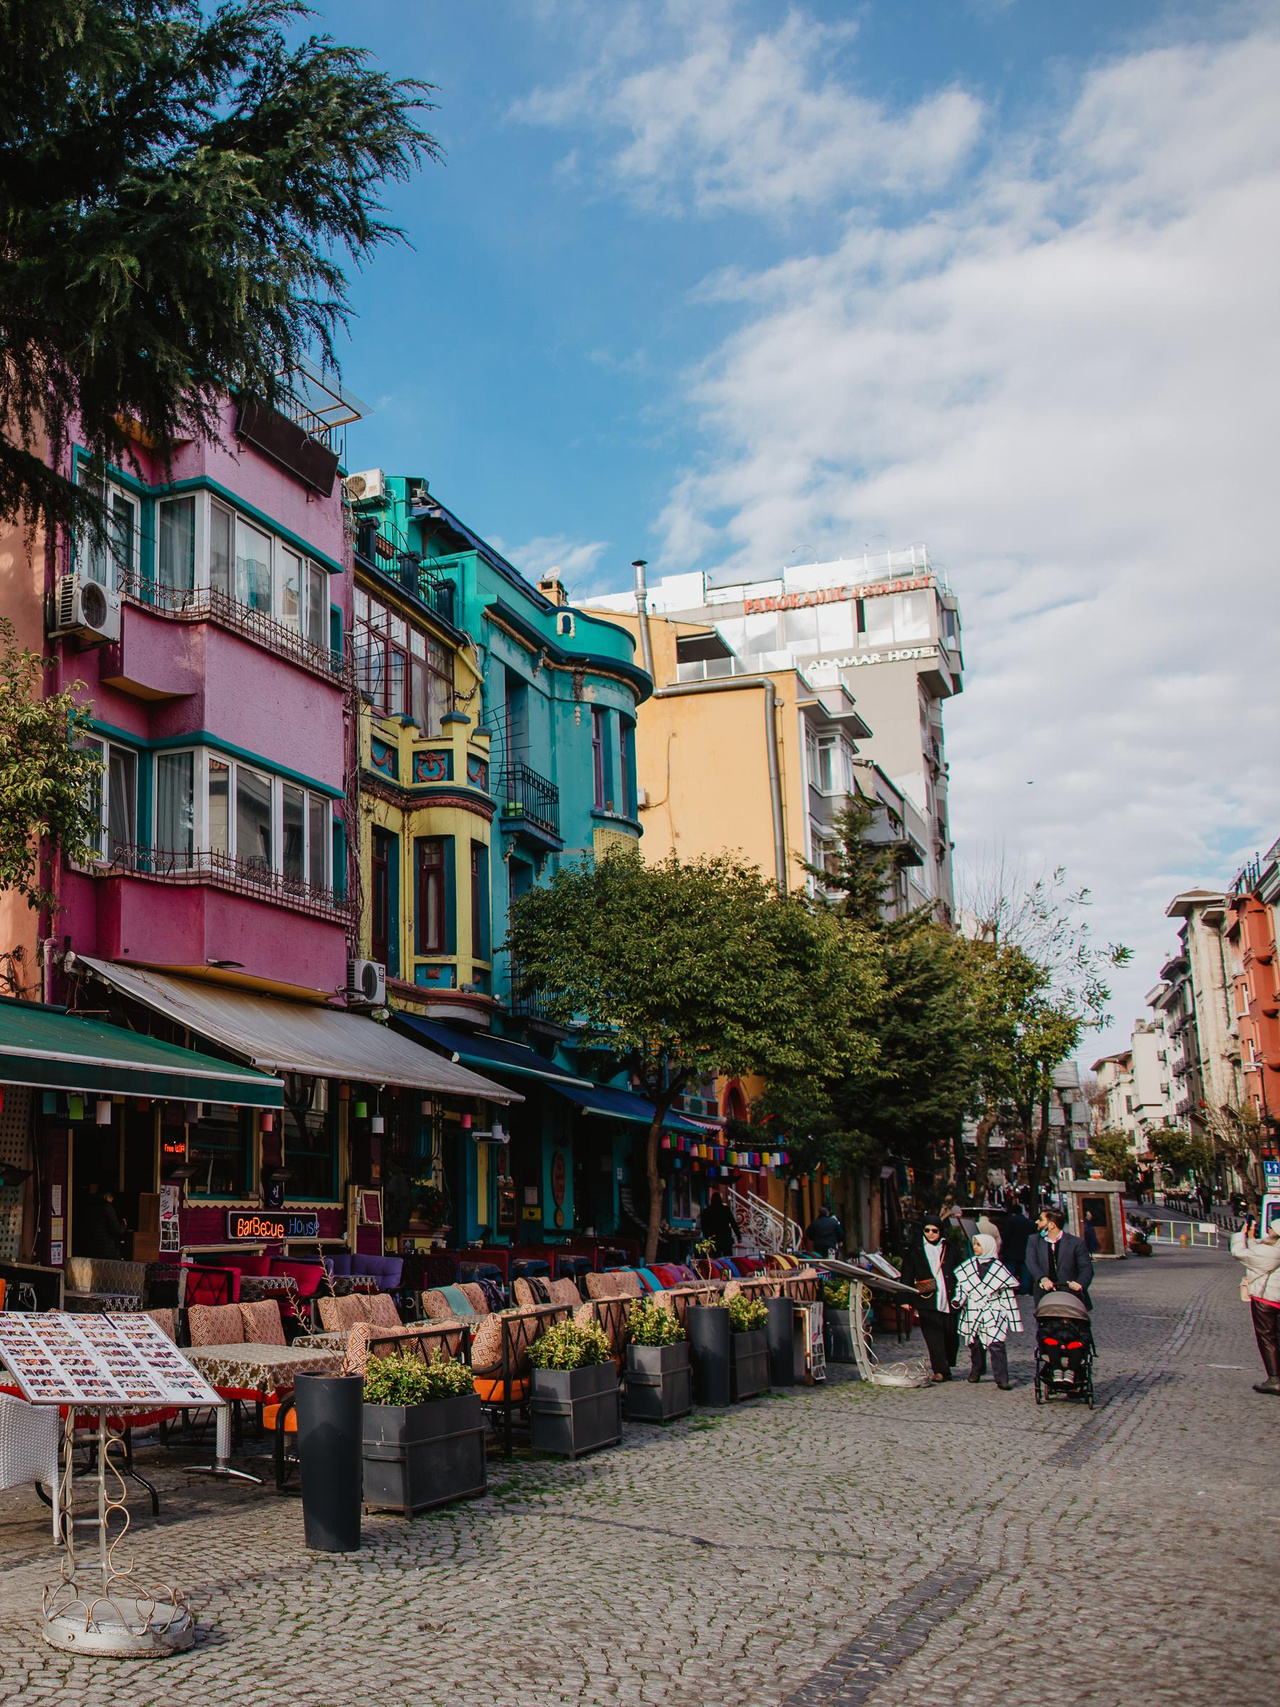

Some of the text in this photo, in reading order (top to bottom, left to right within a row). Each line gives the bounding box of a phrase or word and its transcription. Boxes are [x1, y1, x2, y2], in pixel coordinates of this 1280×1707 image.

[744, 576, 930, 615] PANORAMIC RESTAURANT
[807, 646, 939, 672] ADAMAR HOTEL
[288, 1217, 320, 1237] House
